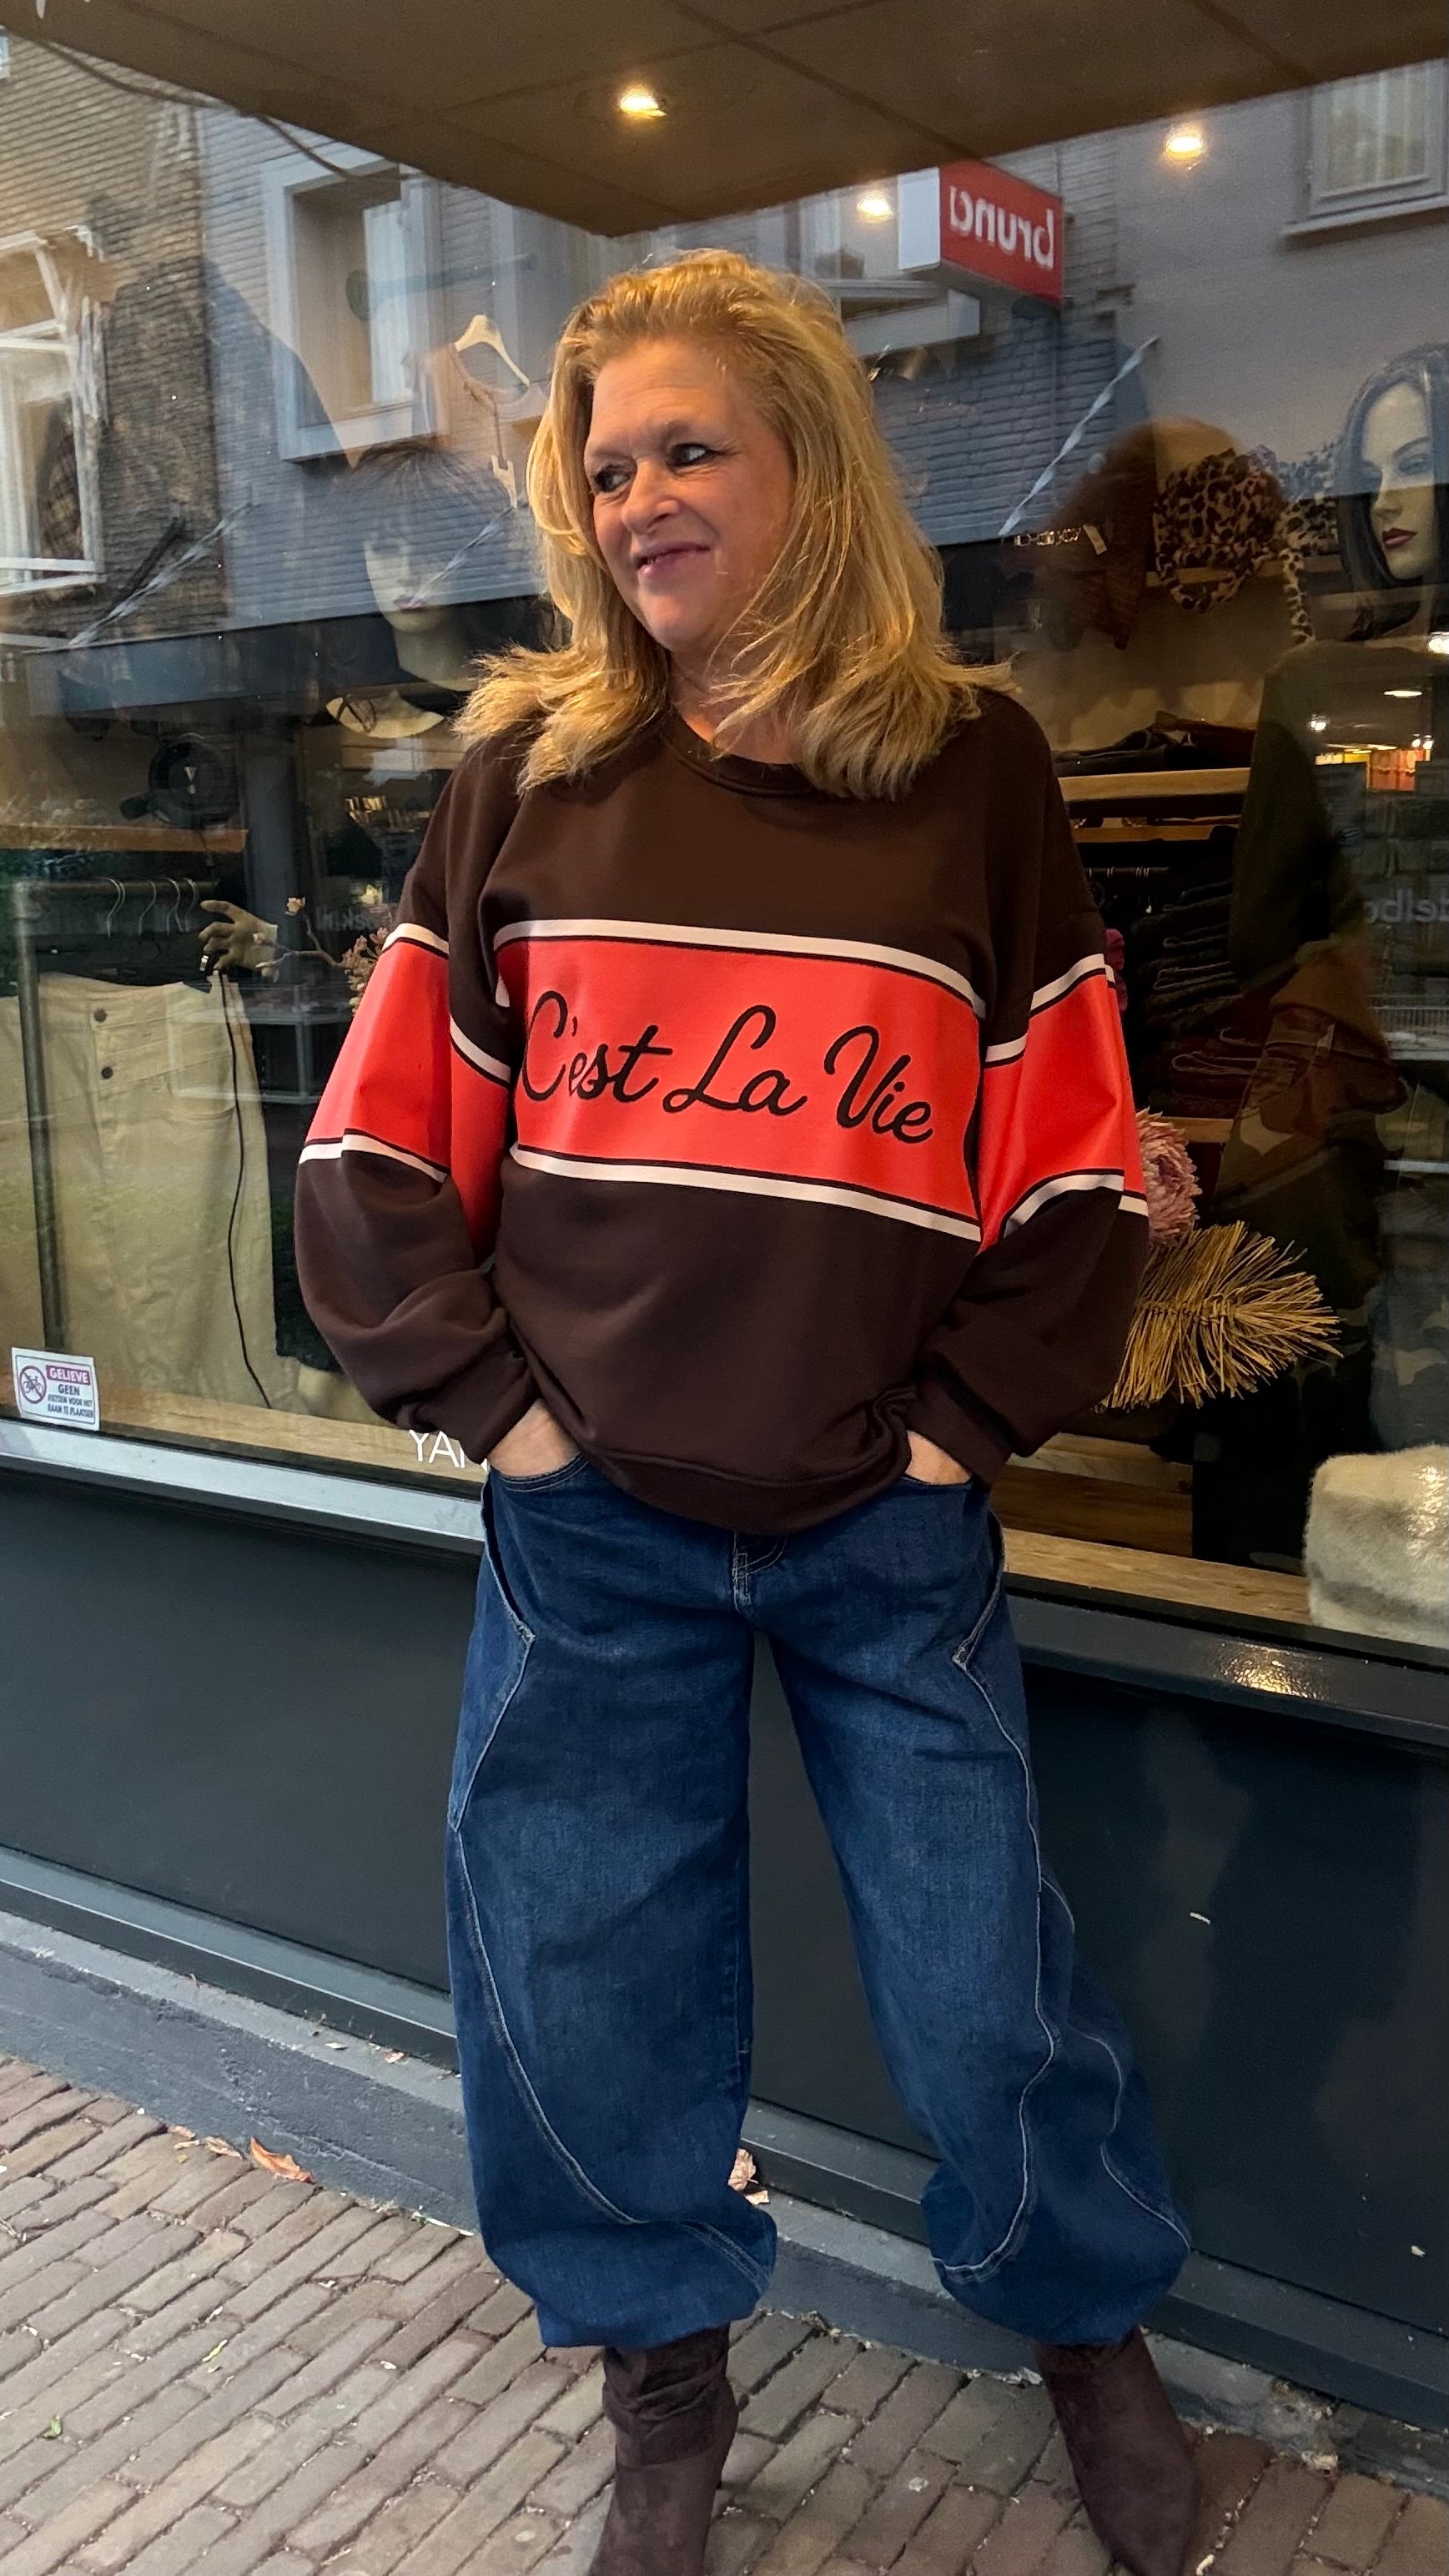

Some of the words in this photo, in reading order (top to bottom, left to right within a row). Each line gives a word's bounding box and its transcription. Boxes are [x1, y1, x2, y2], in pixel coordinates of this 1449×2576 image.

[522, 990, 673, 1102] C'est
[662, 1004, 808, 1116] La
[823, 1024, 933, 1144] Vie
[49, 1367, 88, 1383] GELIEVE
[58, 1383, 80, 1396] GEEN
